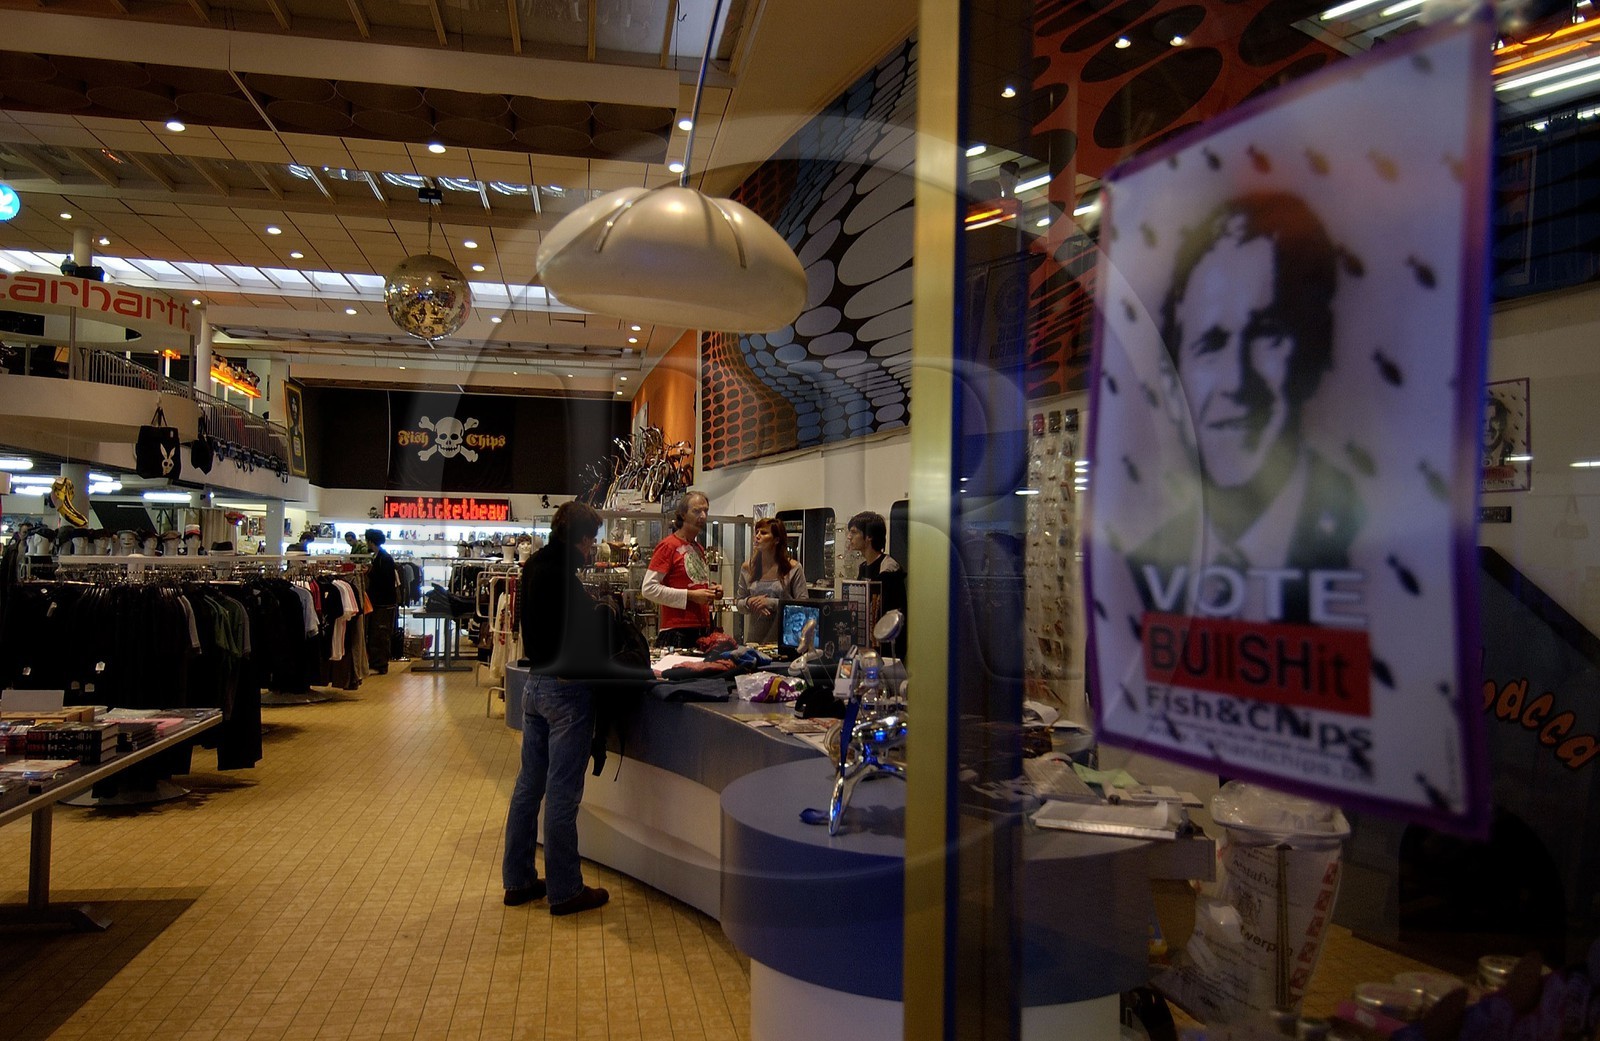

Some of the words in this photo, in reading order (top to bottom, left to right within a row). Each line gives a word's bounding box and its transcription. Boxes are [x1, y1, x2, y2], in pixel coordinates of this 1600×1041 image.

[0, 273, 190, 330] arhartt
[398, 430, 429, 447] Fish
[465, 433, 506, 451] Chips
[1142, 564, 1370, 627] VOTE
